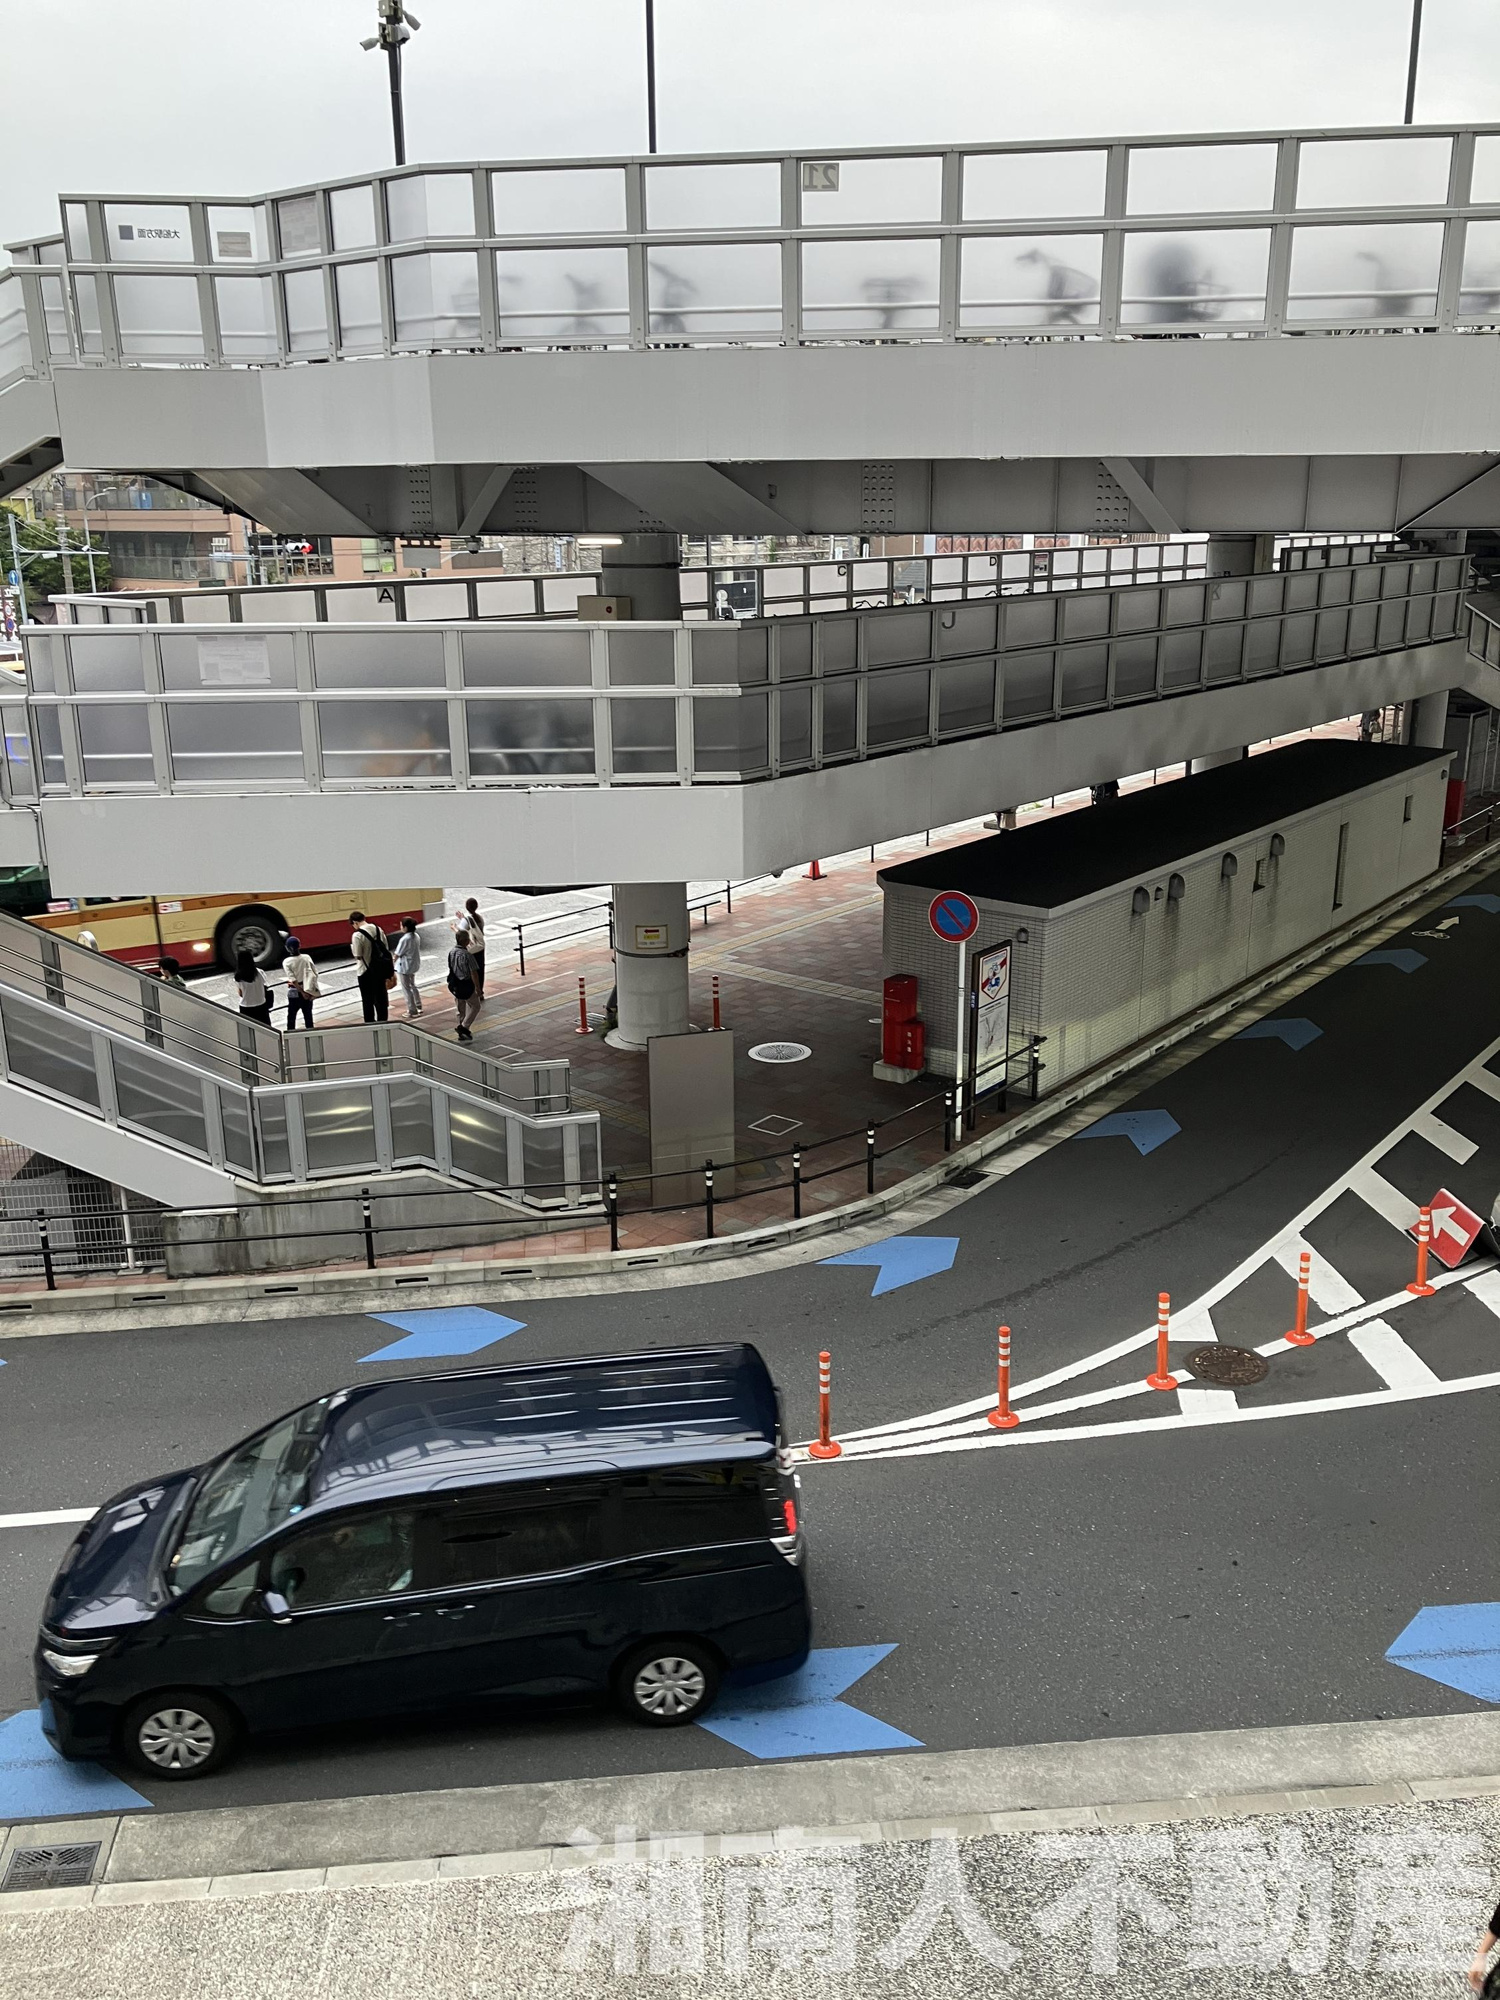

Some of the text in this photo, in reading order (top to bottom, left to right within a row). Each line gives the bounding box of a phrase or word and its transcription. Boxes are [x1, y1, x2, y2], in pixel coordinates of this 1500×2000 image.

[989, 556, 997, 567] D
[837, 565, 847, 576] C
[378, 588, 394, 603] A
[941, 611, 956, 630] J
